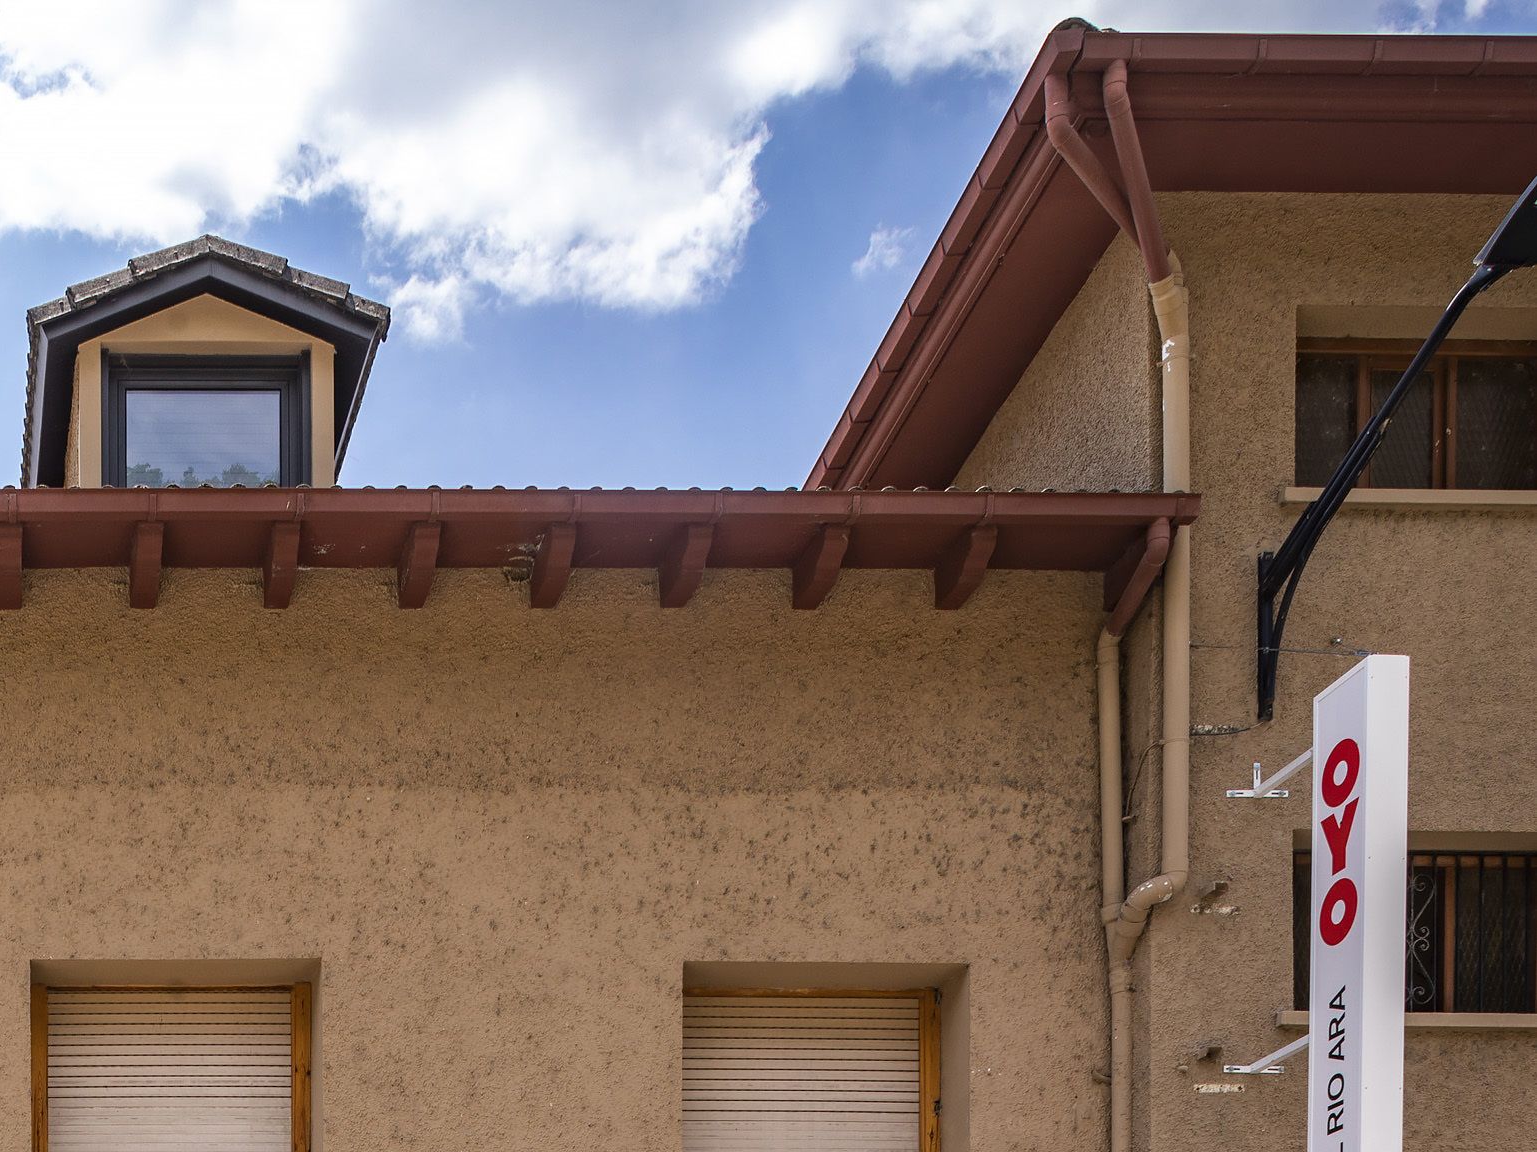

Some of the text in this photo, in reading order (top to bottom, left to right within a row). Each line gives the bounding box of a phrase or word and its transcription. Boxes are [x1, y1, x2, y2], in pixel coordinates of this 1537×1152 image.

[1319, 738, 1361, 946] OYO
[1328, 984, 1347, 1061] ARA
[1326, 1073, 1345, 1136] RIO
